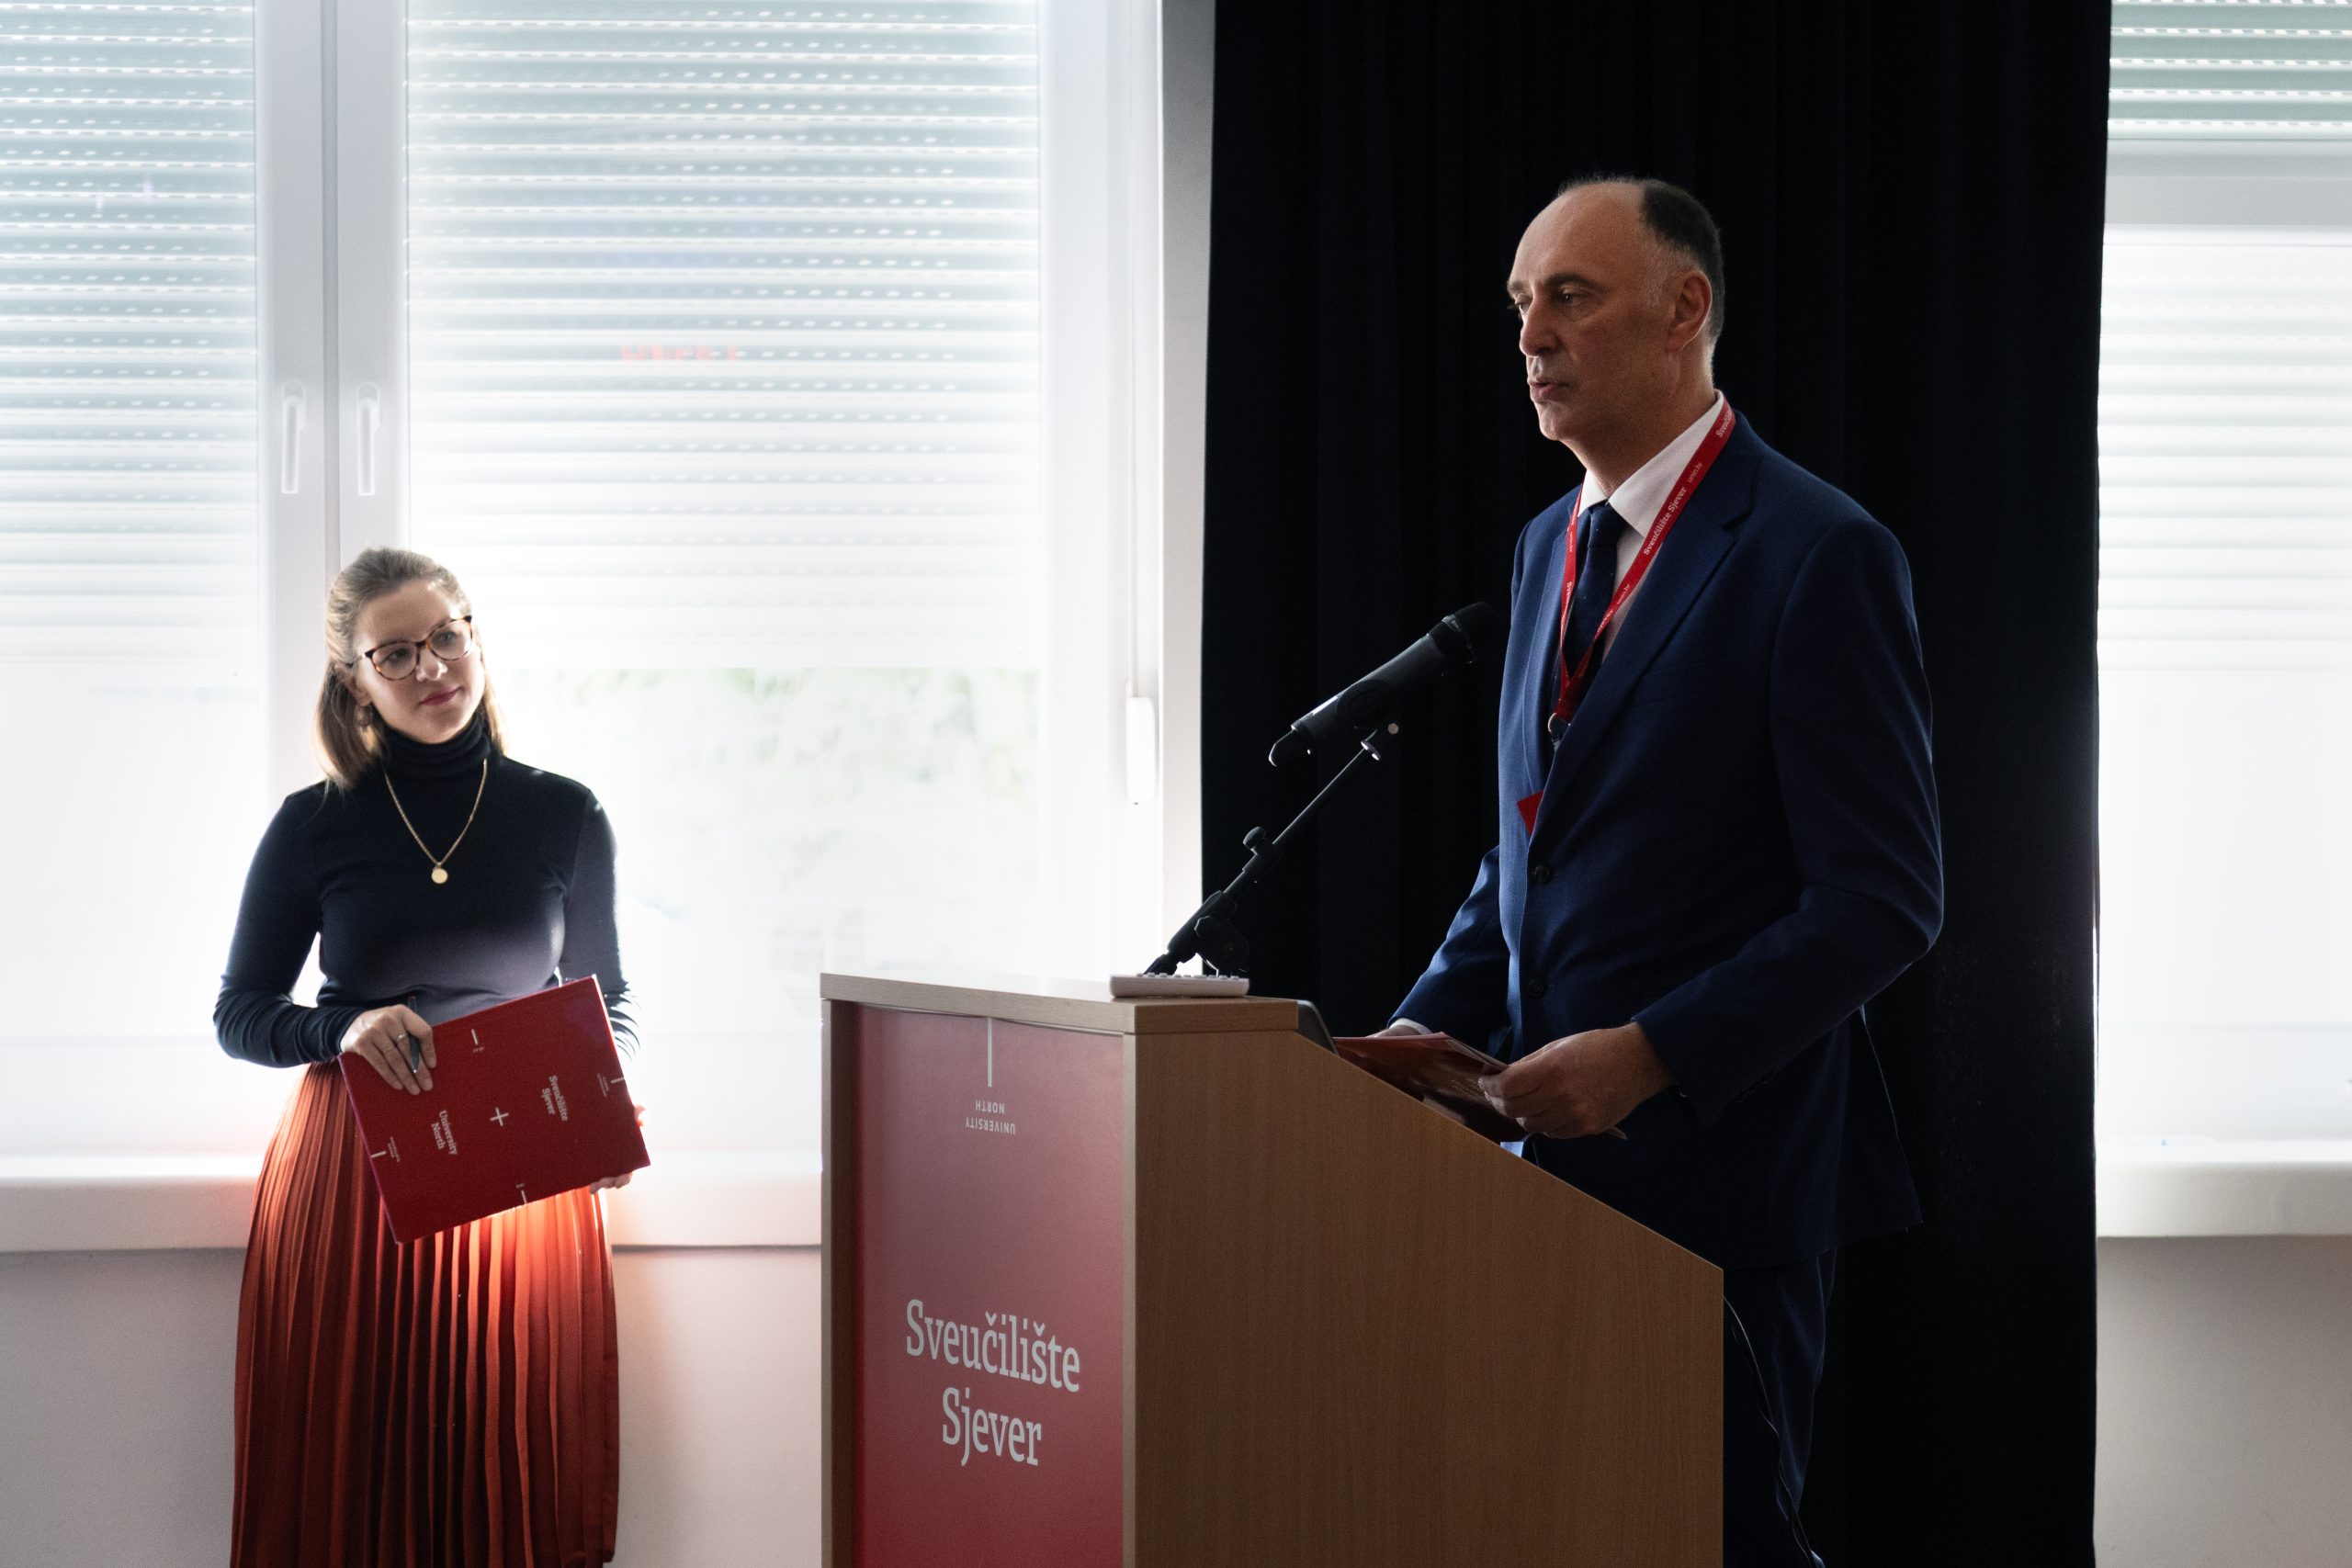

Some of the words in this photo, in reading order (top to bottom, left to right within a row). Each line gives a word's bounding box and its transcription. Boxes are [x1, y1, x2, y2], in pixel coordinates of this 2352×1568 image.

[1644, 512, 1672, 556] Sveučilište
[1668, 486, 1687, 513] Sjever
[541, 1088, 556, 1115] Sjever
[975, 1099, 1005, 1114] NORTH
[431, 1122, 447, 1150] North
[438, 1110, 458, 1155] University
[965, 1116, 1015, 1135] UNIVERSITY
[905, 1299, 1080, 1393] Sveučilište
[941, 1385, 1043, 1467] Sjever
